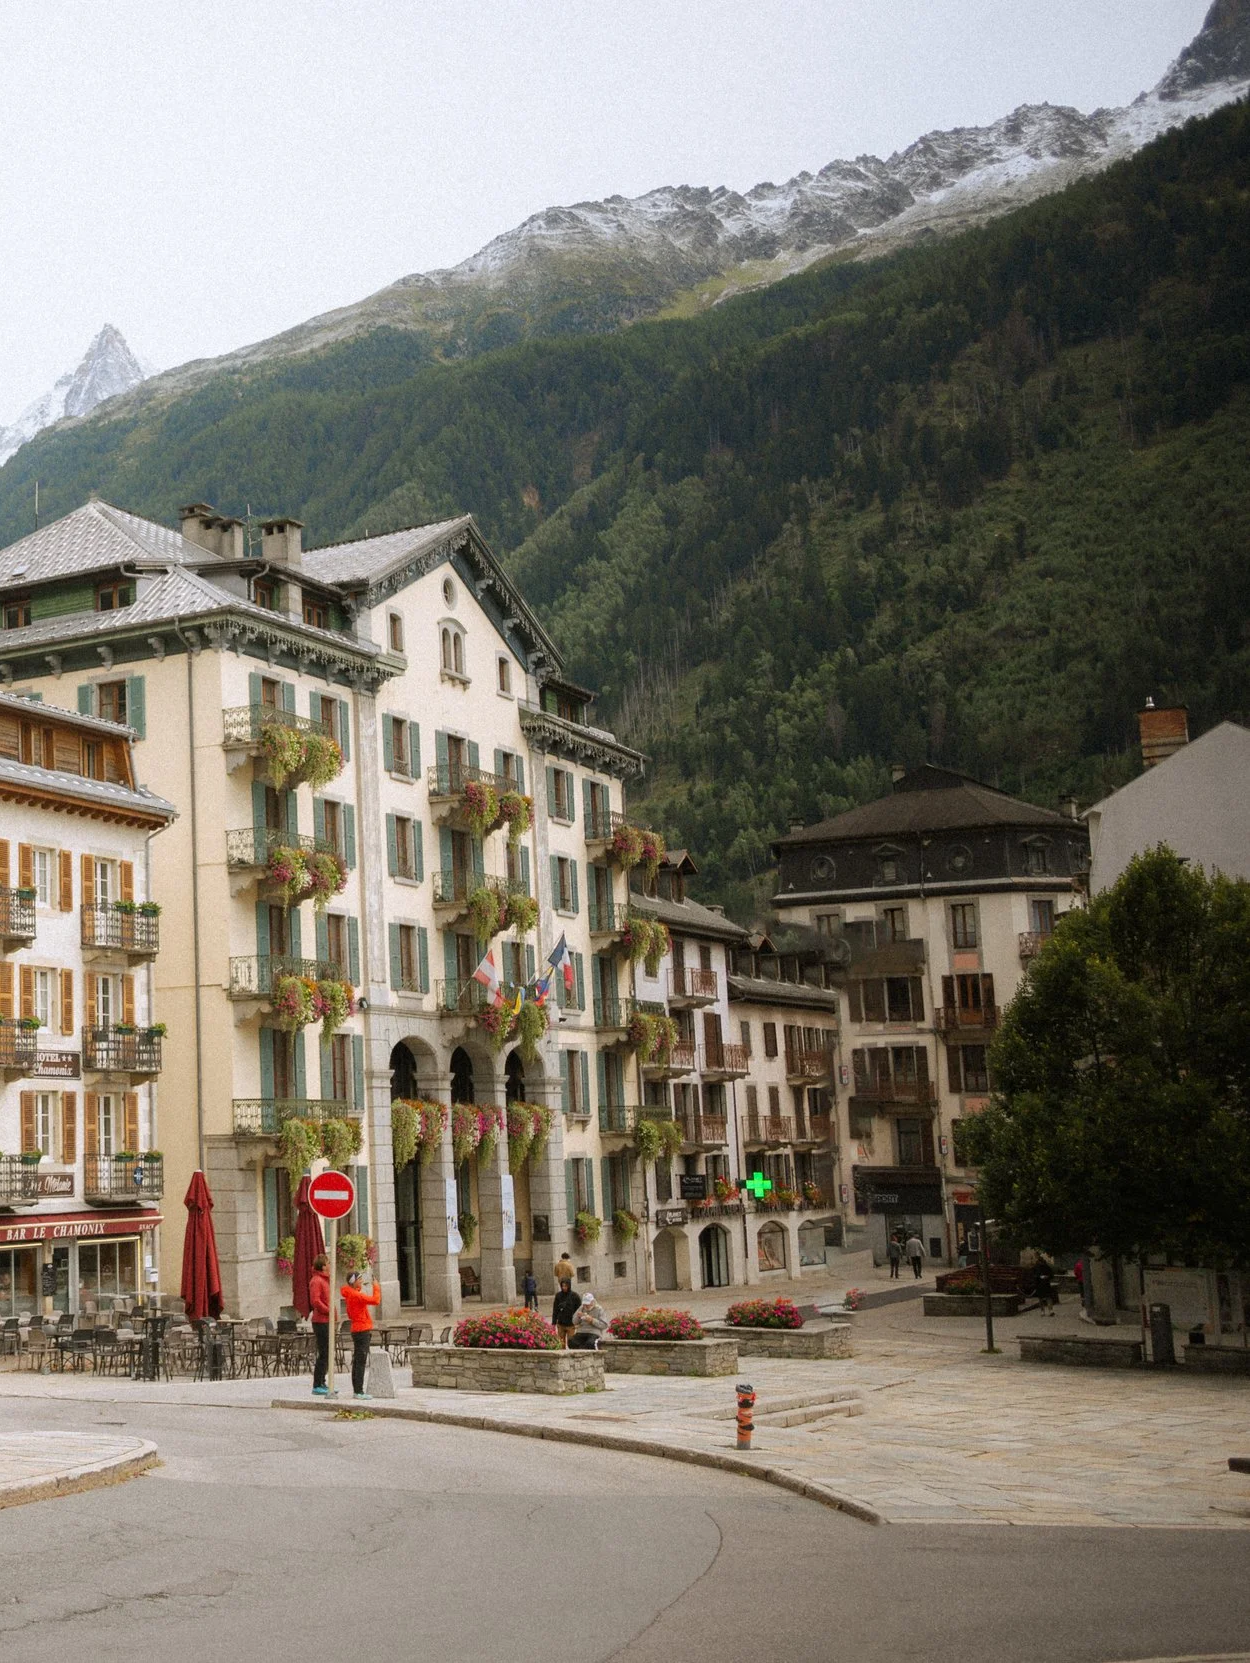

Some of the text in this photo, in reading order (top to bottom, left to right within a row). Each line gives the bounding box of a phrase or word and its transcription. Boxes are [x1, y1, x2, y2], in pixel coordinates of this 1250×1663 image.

[6, 1223, 105, 1241] BAR LE CHAMONIX
